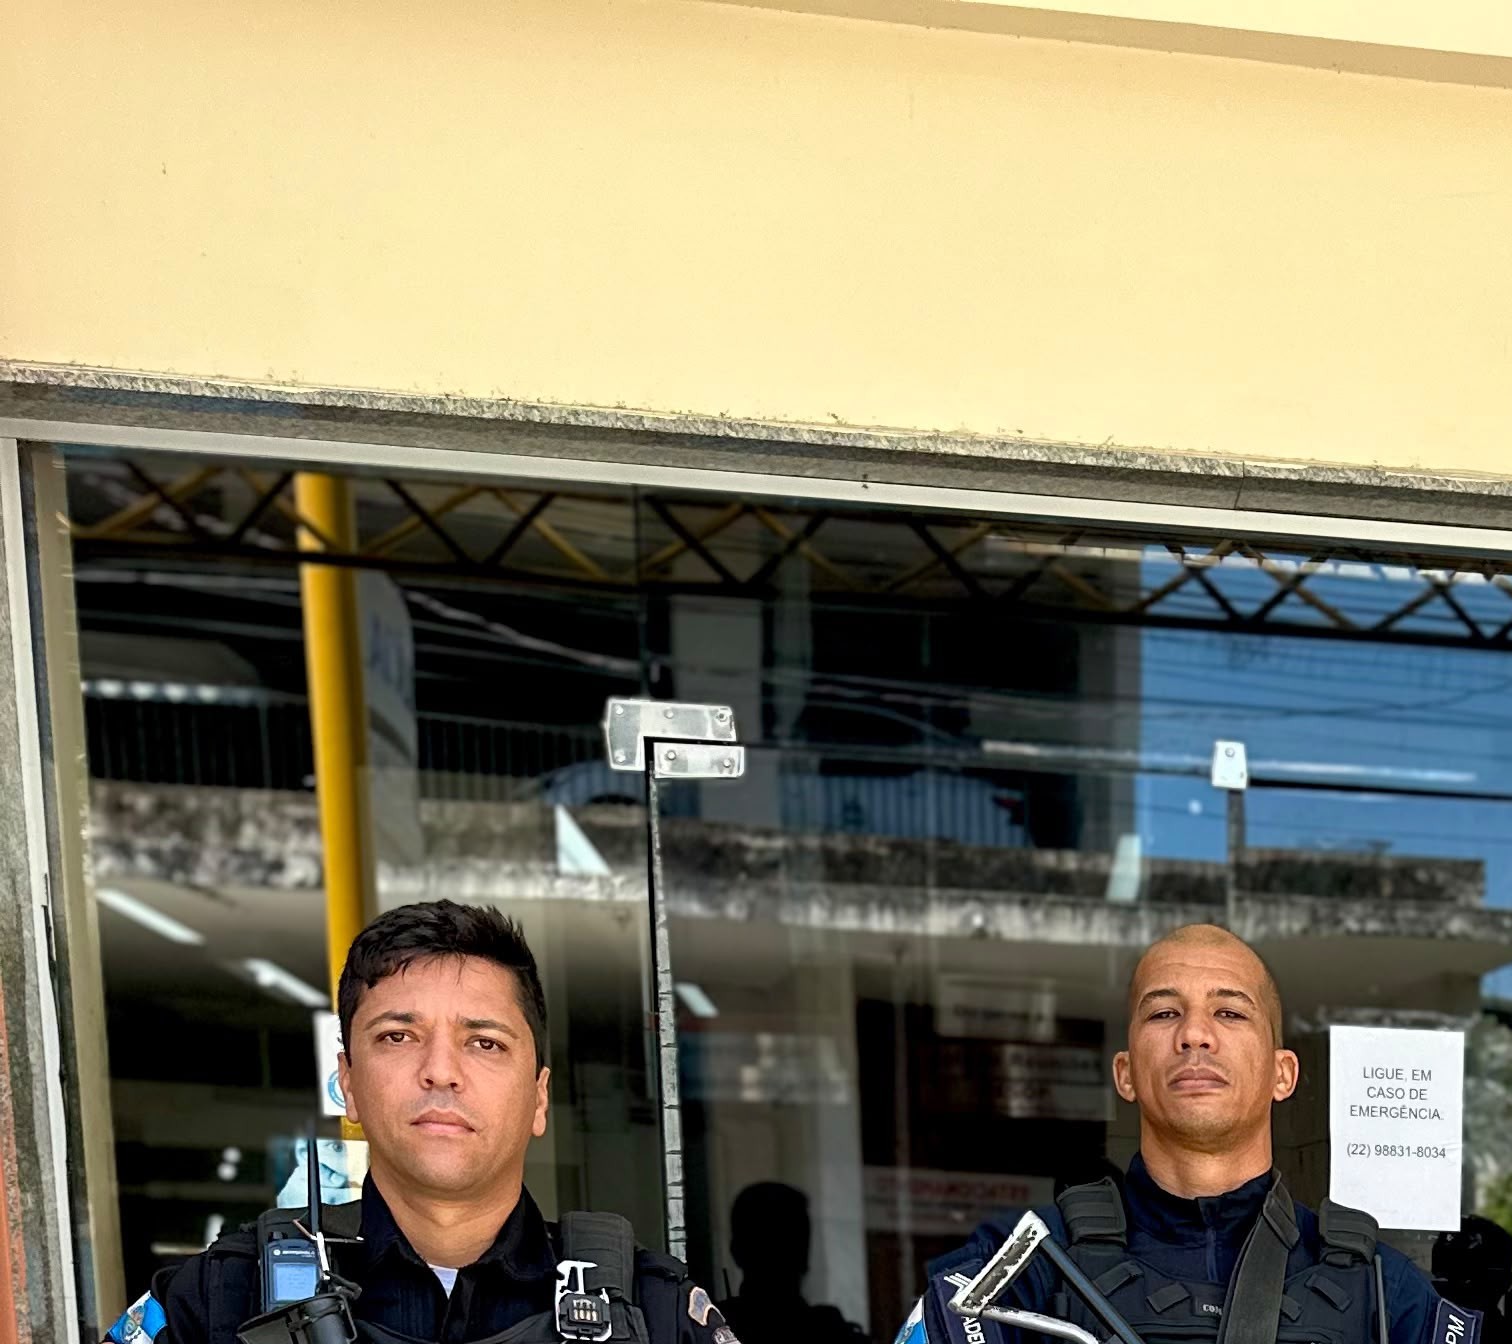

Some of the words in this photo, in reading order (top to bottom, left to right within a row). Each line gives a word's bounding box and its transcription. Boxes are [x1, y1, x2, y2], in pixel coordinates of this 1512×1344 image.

[1363, 1066, 1407, 1082] LIGUE,
[1411, 1069, 1432, 1081] EM
[1366, 1086, 1405, 1100] CASO
[1409, 1088, 1428, 1100] DE
[1346, 1143, 1371, 1158] (22)
[1374, 1144, 1446, 1159] 98831-8034
